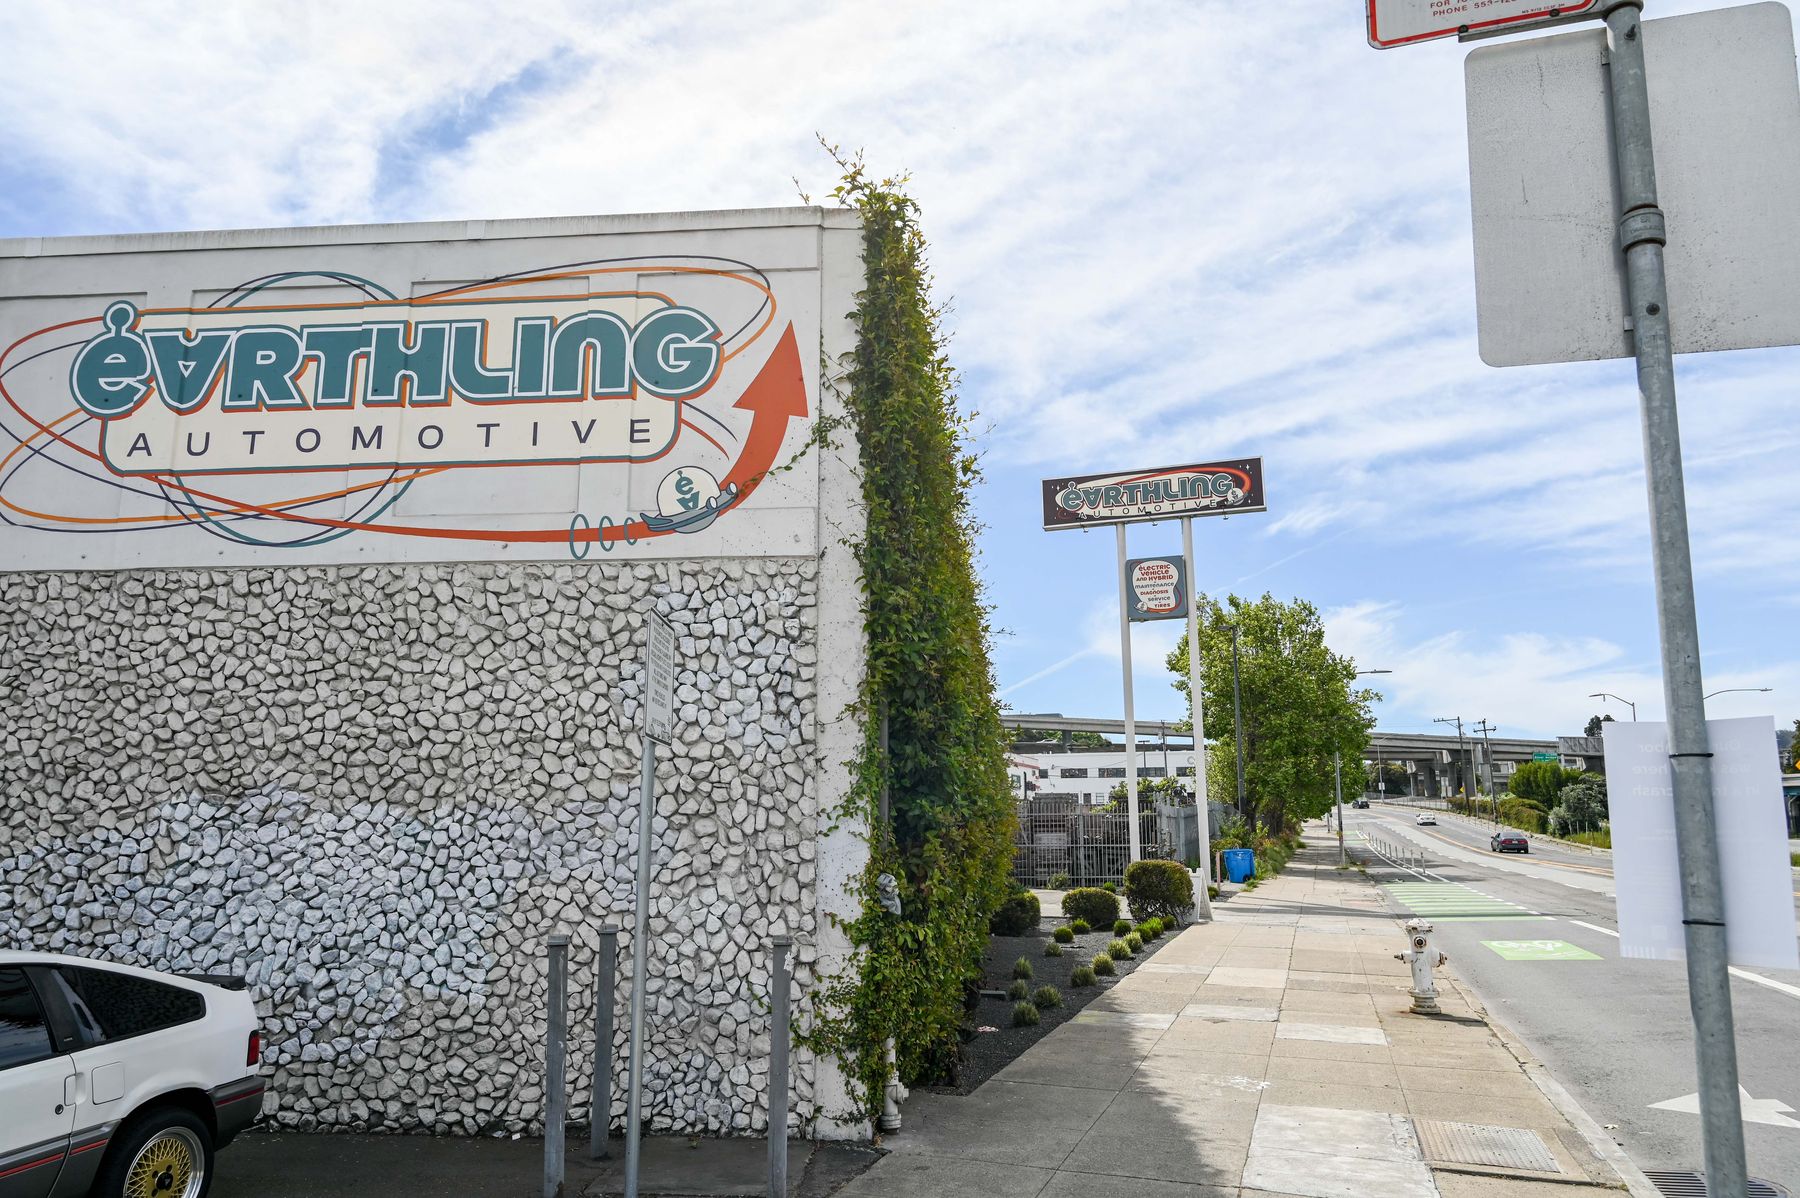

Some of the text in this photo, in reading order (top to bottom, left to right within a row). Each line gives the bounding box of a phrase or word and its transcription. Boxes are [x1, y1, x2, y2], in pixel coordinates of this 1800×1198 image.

[1430, 0, 1450, 8] FOR
[1432, 5, 1468, 16] PHONE
[126, 418, 651, 458] AUTOMOTIVE
[1078, 499, 1217, 520] AUTOMOTIVE
